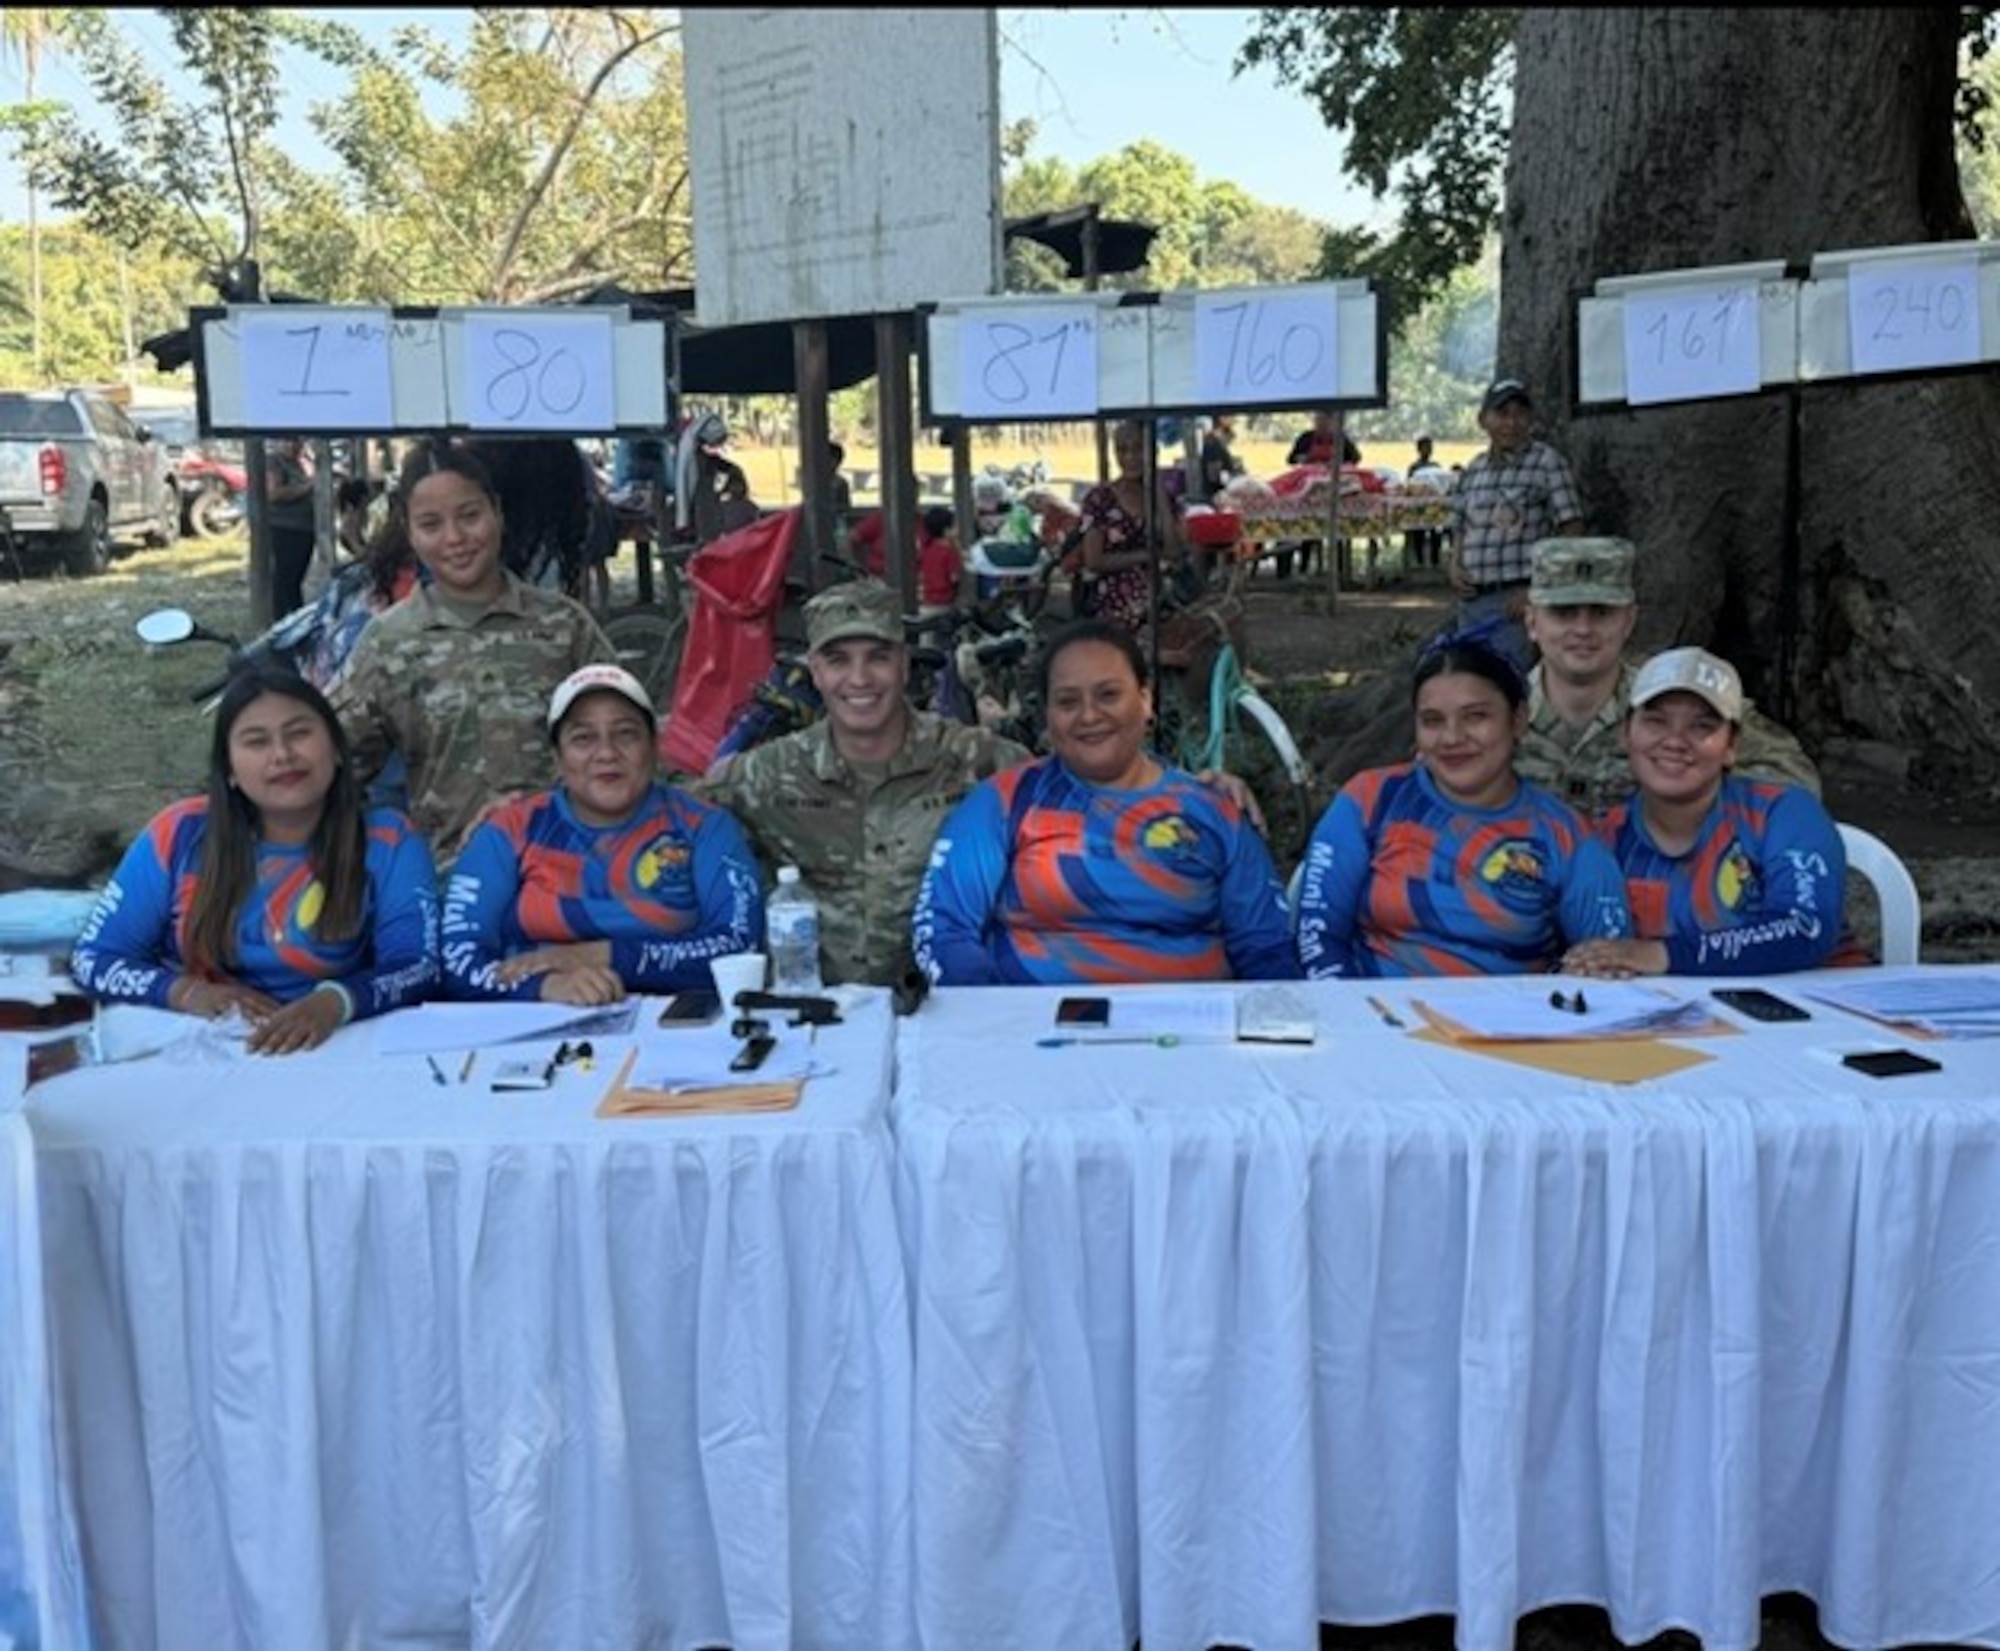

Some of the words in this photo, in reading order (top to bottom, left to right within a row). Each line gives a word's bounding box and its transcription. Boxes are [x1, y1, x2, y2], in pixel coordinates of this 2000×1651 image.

[1646, 303, 1735, 365] 161
[1871, 283, 1965, 341] 240
[277, 324, 351, 396] 1
[486, 328, 587, 421] 80
[1300, 840, 1334, 910] Muni
